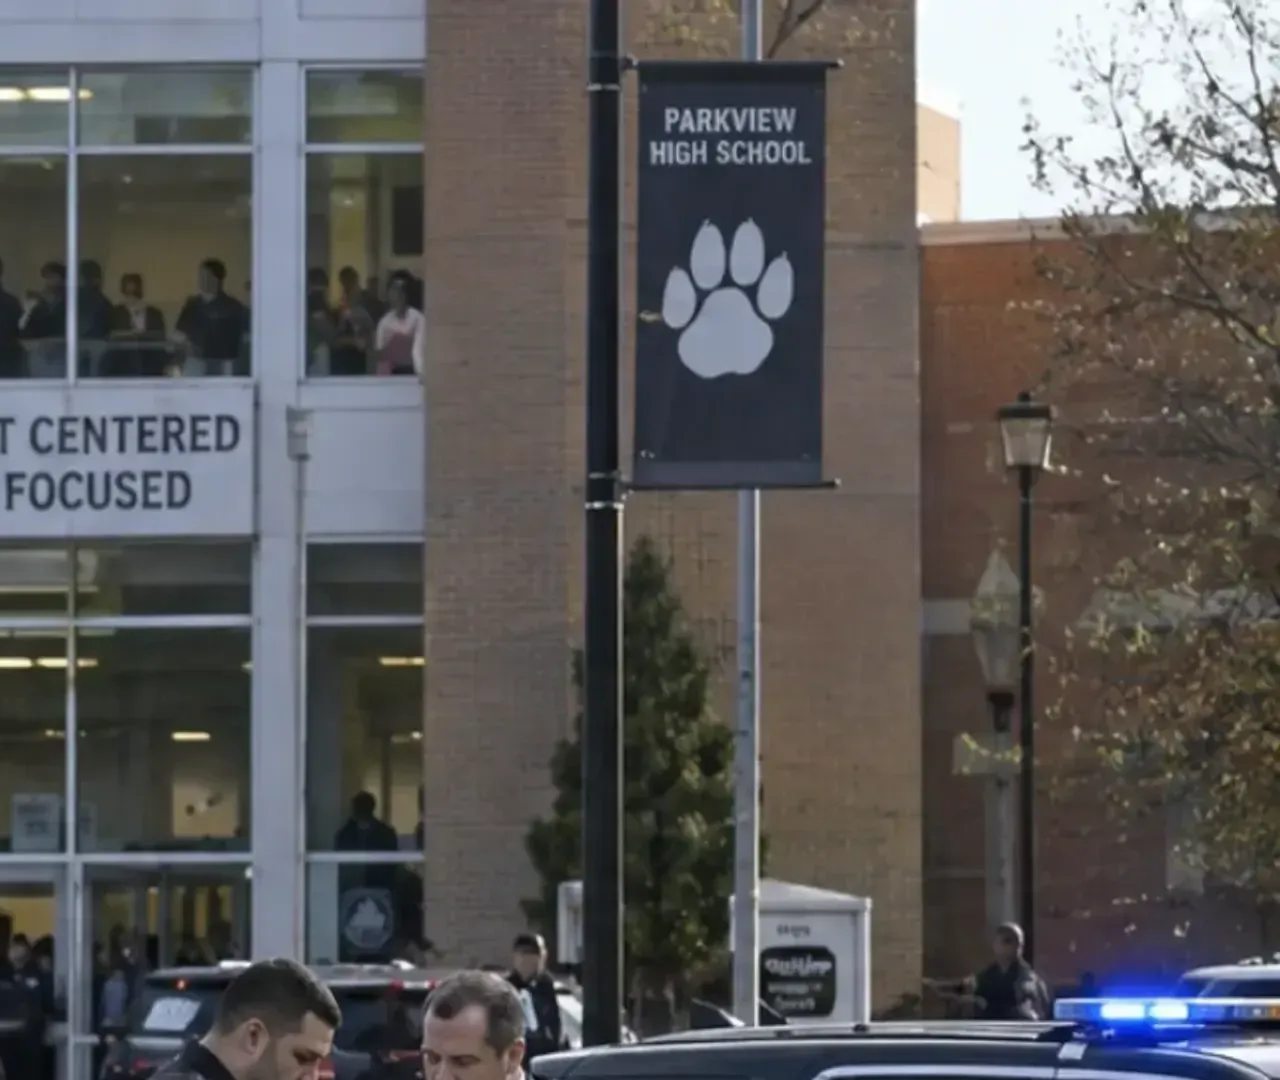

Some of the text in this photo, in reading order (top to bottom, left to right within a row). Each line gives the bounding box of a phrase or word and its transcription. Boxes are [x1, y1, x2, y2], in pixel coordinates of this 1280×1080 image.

[664, 107, 796, 132] PARKVIEW
[650, 139, 811, 165] HIGH SCHOOL
[29, 414, 240, 455] CENTERED
[5, 470, 192, 511] FOCUSED
